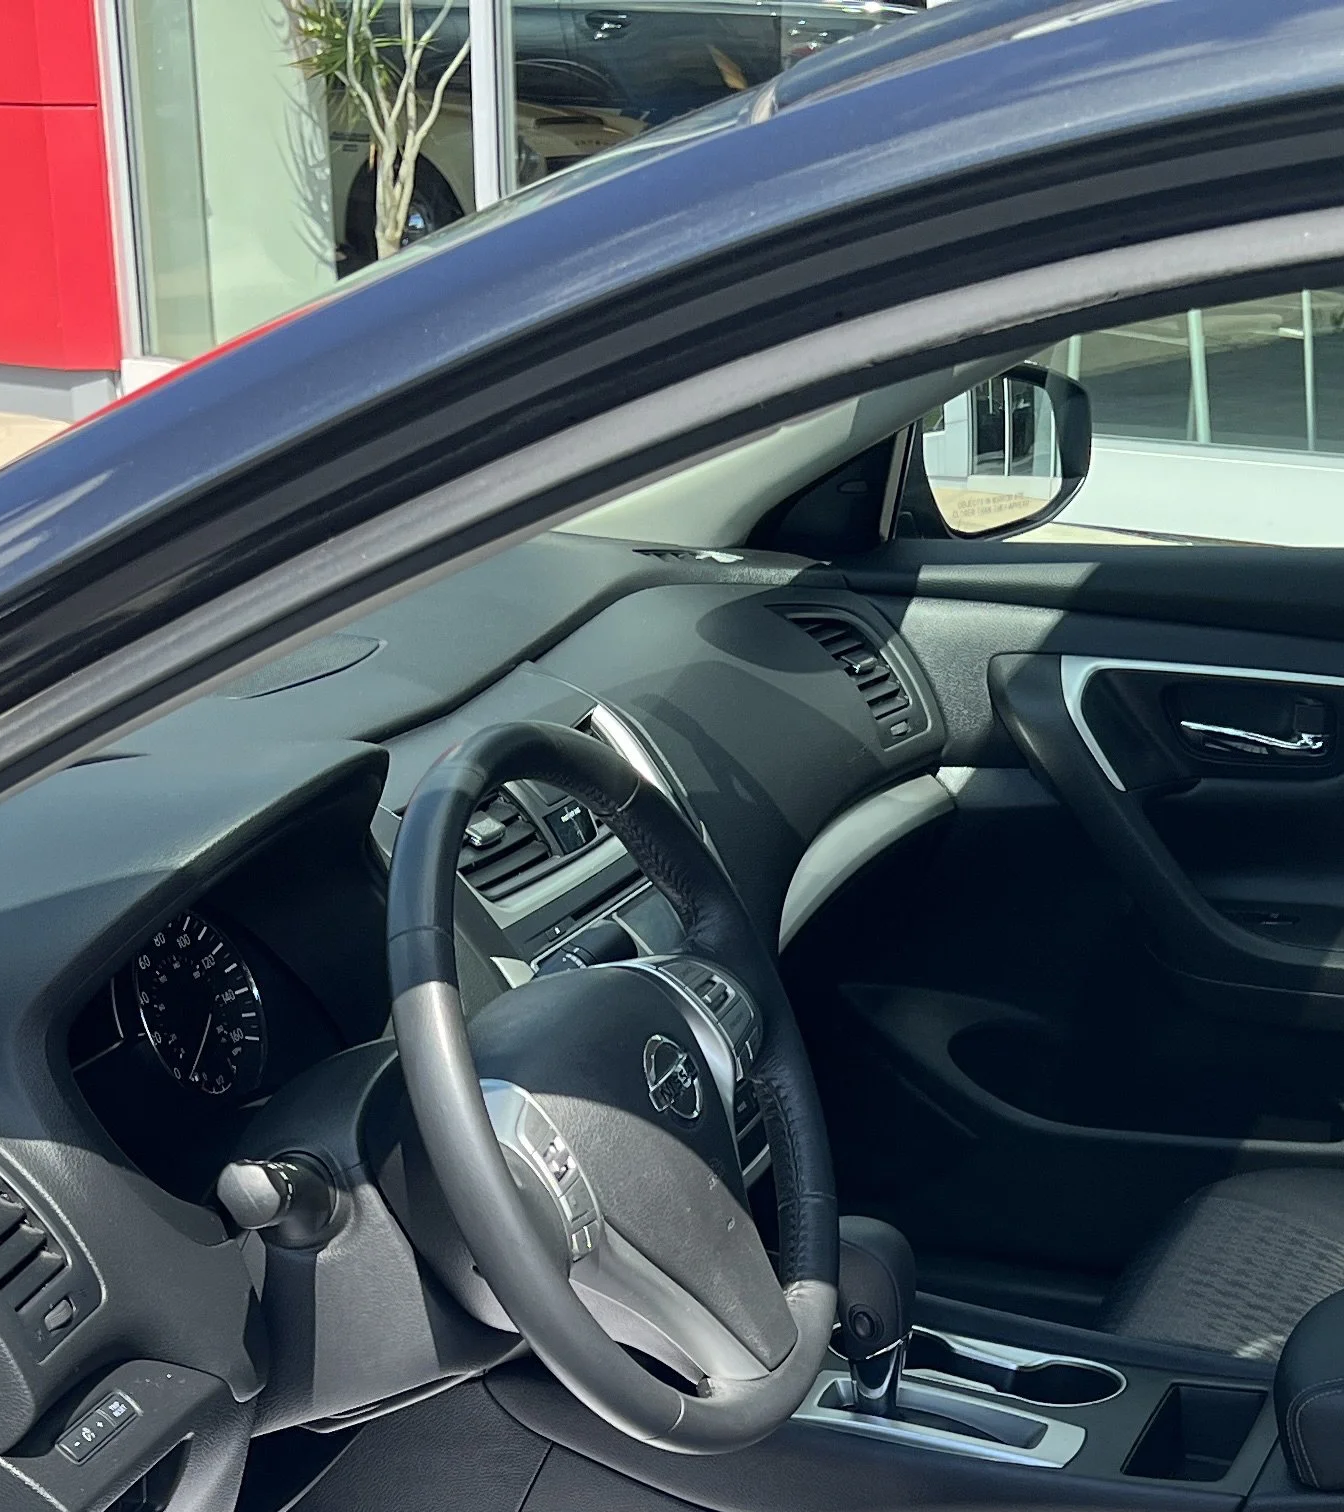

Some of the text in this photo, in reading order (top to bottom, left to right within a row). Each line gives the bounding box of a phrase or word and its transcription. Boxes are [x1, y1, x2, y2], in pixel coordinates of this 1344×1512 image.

[154, 932, 166, 947] 80
[177, 934, 191, 949] 100
[138, 954, 151, 970] 60
[202, 954, 216, 970] 120
[229, 1027, 244, 1043] 160
[173, 1067, 182, 1080] 0
